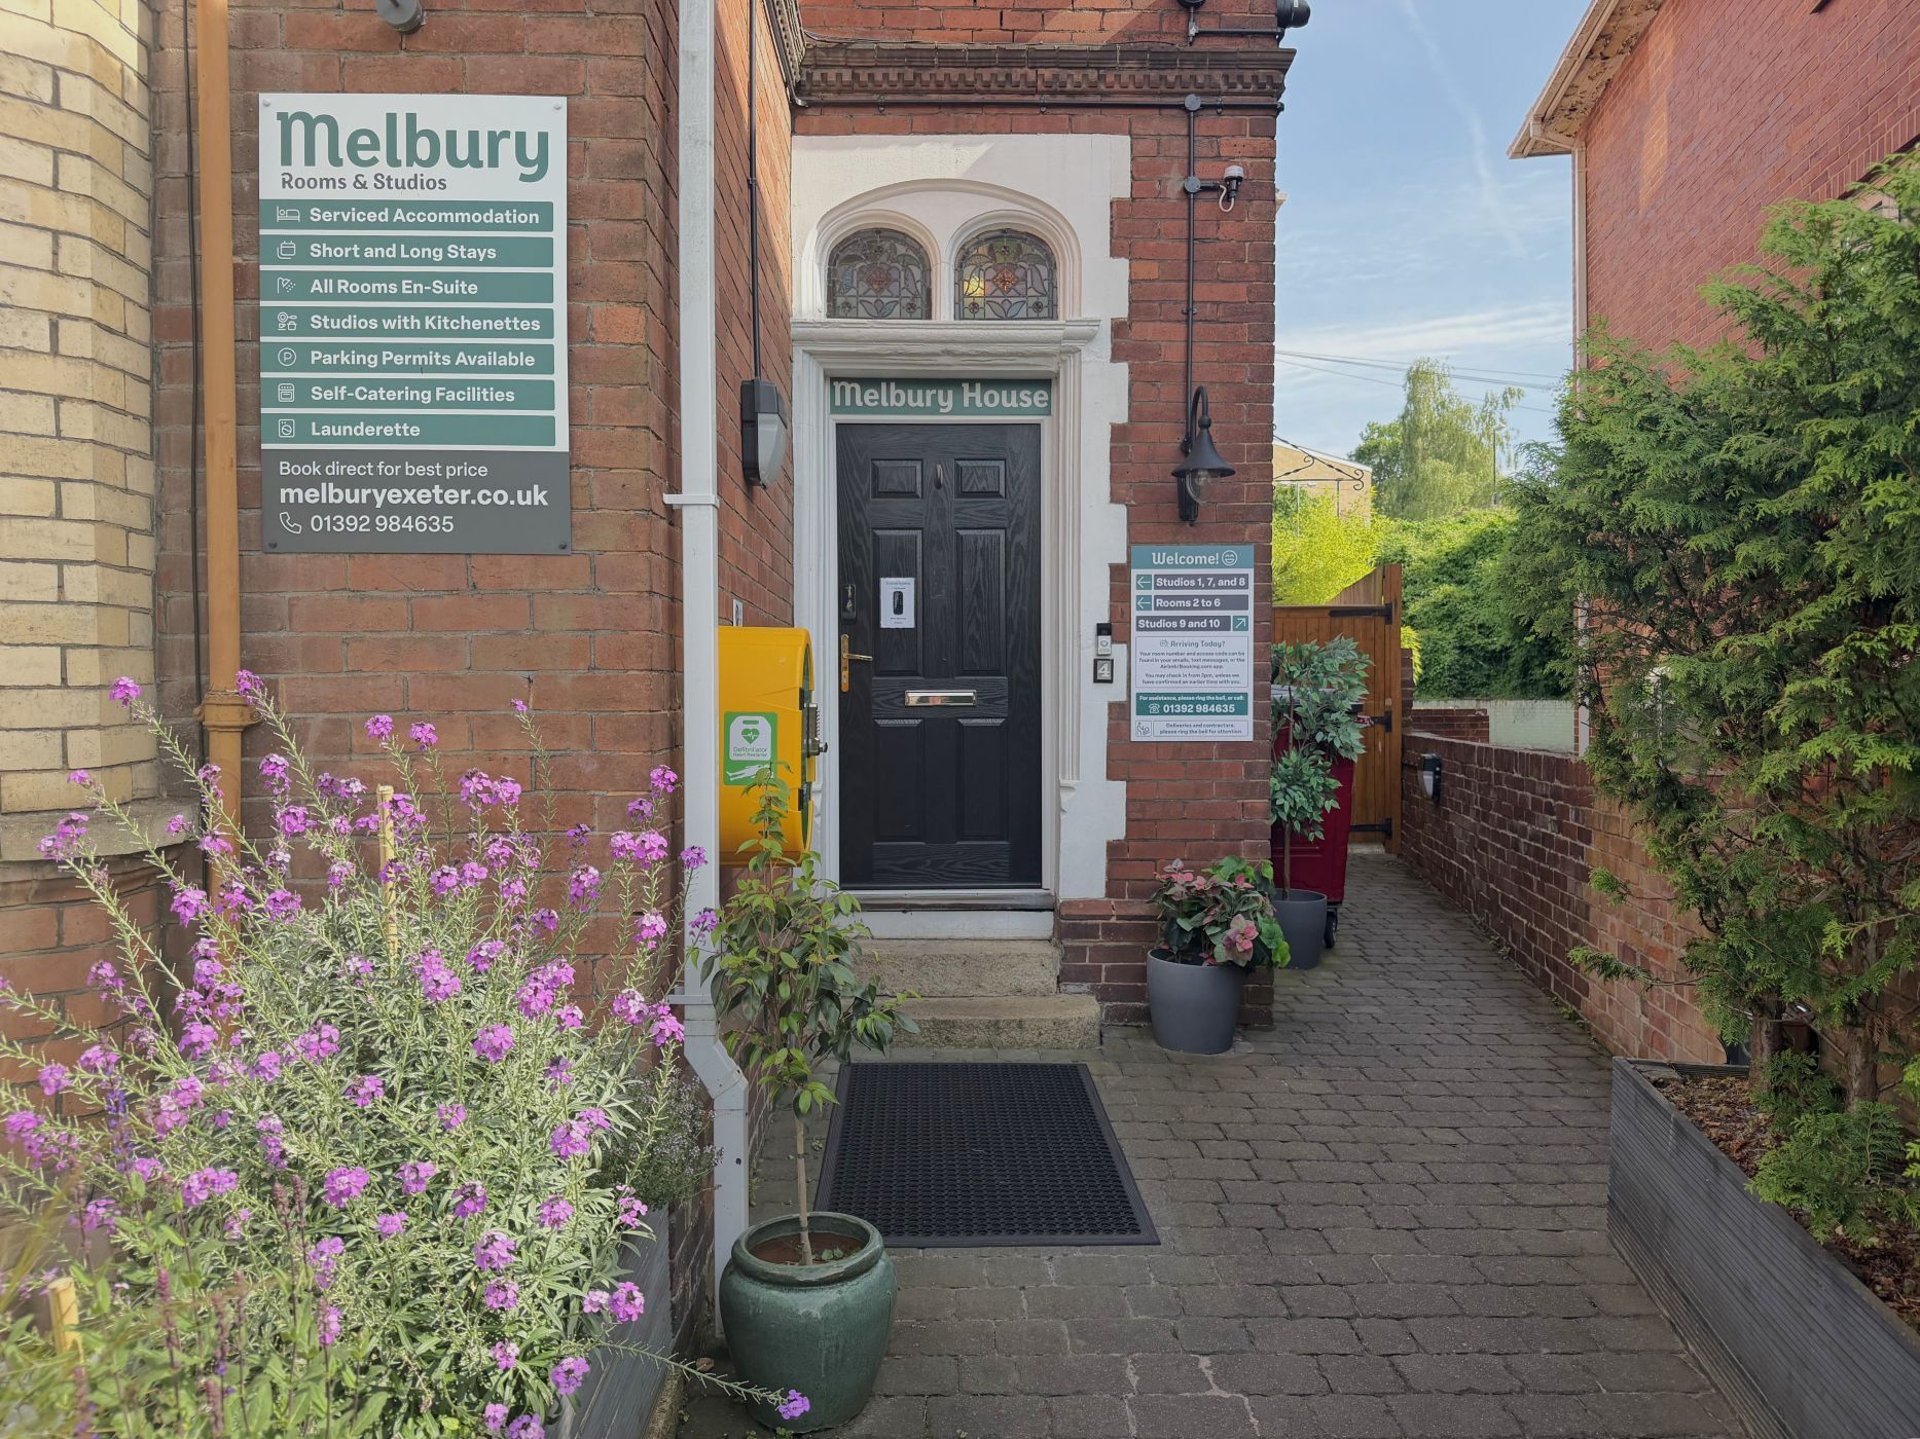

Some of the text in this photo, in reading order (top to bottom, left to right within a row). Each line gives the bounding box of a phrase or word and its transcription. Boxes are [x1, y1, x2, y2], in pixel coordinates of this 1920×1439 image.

[276, 110, 549, 183] Melbury
[281, 172, 447, 191] Rooms & Studios
[309, 207, 540, 224] Serviced Accommodation
[309, 243, 497, 262] Short and Long Stays
[310, 278, 478, 295] All Rooms En-Suite
[310, 314, 541, 331] Studios with Kitchenettes
[310, 350, 536, 368] Parking Permits Available
[311, 385, 515, 404] Self-Catering Facilities
[833, 380, 1049, 413] Melbury House
[311, 421, 421, 437] Launderette
[279, 460, 489, 479] Book direct for best price
[280, 482, 549, 509] melburyexeter.co.uk
[310, 514, 454, 532] 01392 984635
[1151, 552, 1219, 565] Welcome!
[1156, 577, 1246, 588] Studios 1, 7, and 8
[1156, 598, 1221, 608] Rooms 2 to 6
[1138, 619, 1221, 629] Studios 9 and 10
[1170, 640, 1226, 649] Arriving Today?
[1099, 663, 1110, 677] 4
[1162, 703, 1236, 713] 01392 984635
